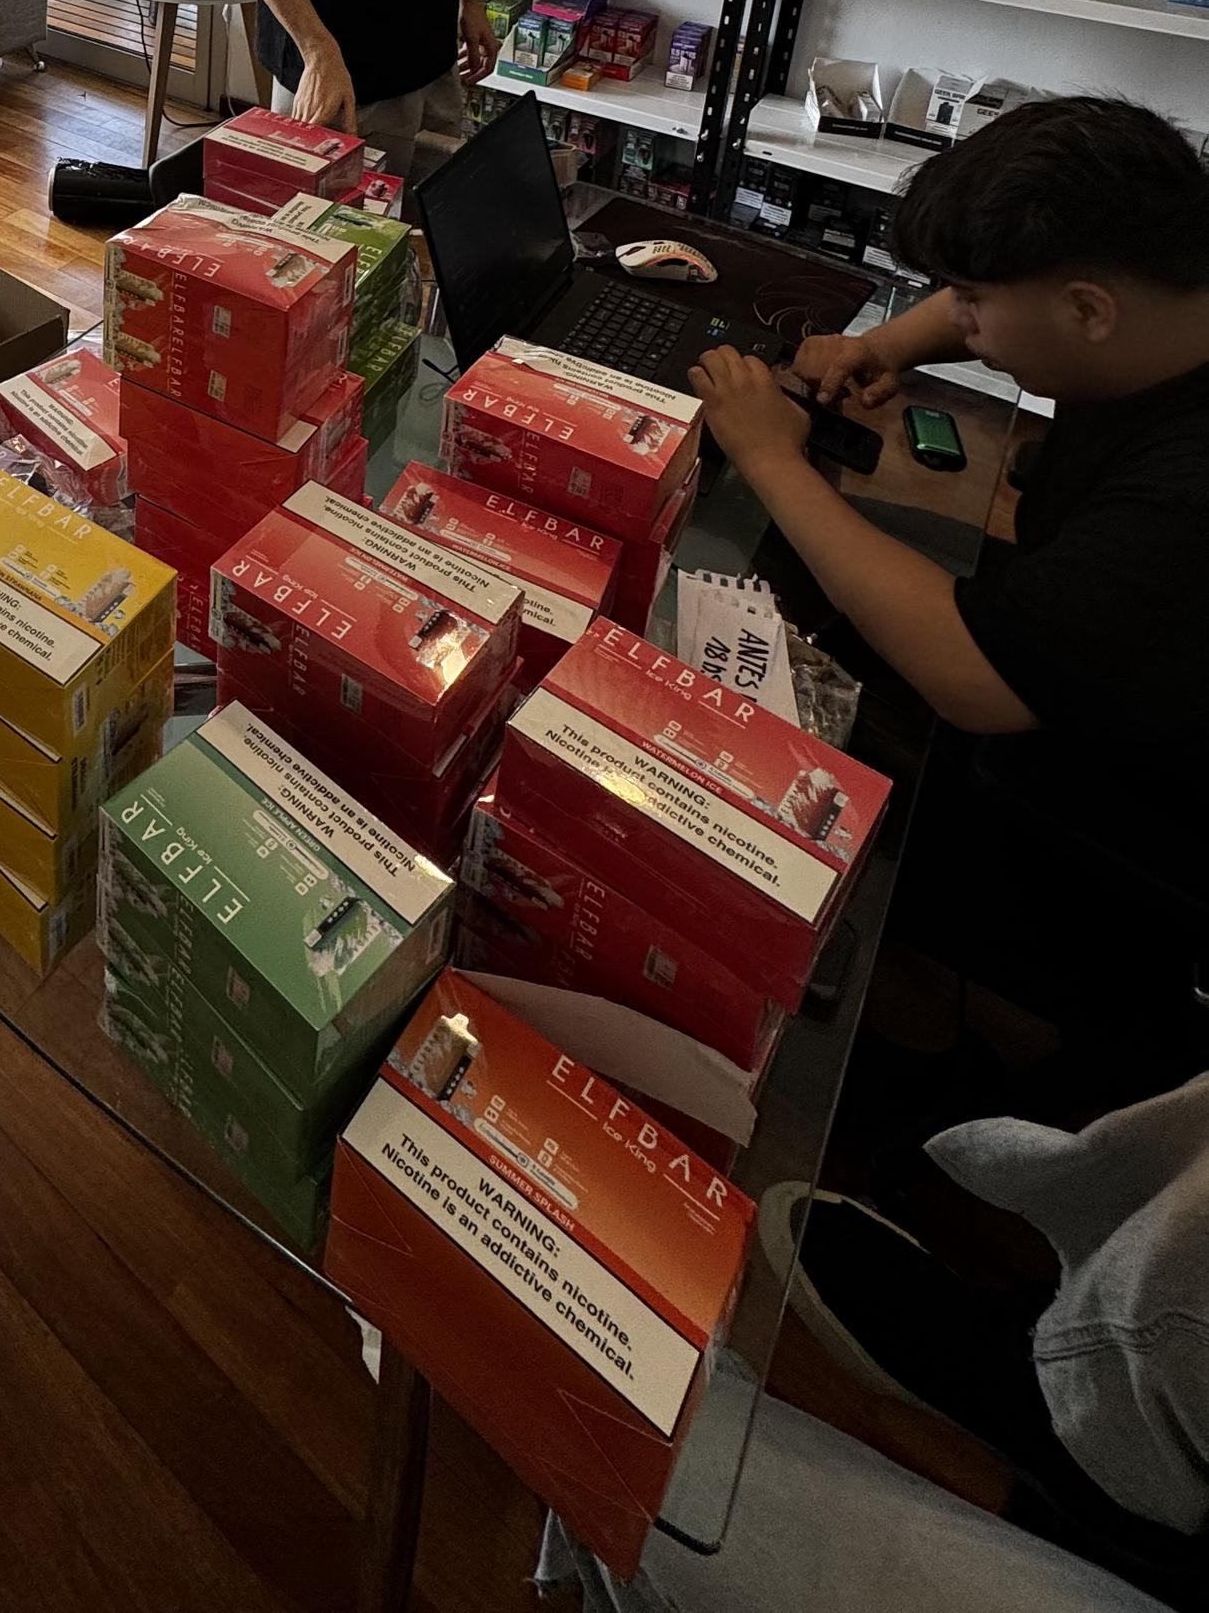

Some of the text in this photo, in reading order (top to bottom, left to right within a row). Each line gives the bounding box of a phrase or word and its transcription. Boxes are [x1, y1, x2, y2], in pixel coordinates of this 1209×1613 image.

[462, 387, 575, 440] ELFBAR
[636, 380, 676, 401] Nicotine
[365, 528, 408, 553] contains
[370, 520, 417, 548] addictive
[486, 494, 605, 550] ELFBAR
[362, 536, 417, 572] WARNING:
[408, 551, 452, 577] product
[417, 545, 433, 556] an
[433, 553, 445, 563] is
[444, 559, 490, 589] Nicotine
[232, 560, 353, 640] ELFBAR
[452, 575, 475, 593] This
[523, 597, 553, 615] otine.
[7, 627, 52, 661] chemical.
[15, 617, 55, 649] nicotine.
[523, 608, 556, 626] mical.
[292, 624, 310, 695] ELFBAR
[603, 627, 755, 723] ELFBAR
[734, 628, 770, 689] ANTES
[633, 755, 711, 810] WARNING:
[641, 740, 724, 795] WATERMELON ICE
[243, 735, 398, 877] This product contains nicotine.
[245, 722, 416, 873] Nicotine is an addictive chemical.
[277, 784, 335, 839] WARNING:
[544, 729, 601, 769] Nicotine
[707, 834, 781, 888] chemical.
[562, 724, 589, 747] This
[647, 781, 710, 824] contains
[712, 821, 779, 869] nicotine.
[121, 801, 243, 924] ELFBAR
[176, 826, 213, 866] Ice King
[575, 881, 605, 961] ELFBAR
[552, 1054, 727, 1207] ELFBAR
[602, 1122, 657, 1174] Ice King
[478, 1177, 561, 1258] WARNING:
[489, 1154, 576, 1232] SUMMER SPLASH
[381, 1143, 635, 1380] Nicotine is an addictive chemical.
[400, 1133, 633, 1352] This product contains nicotine.
